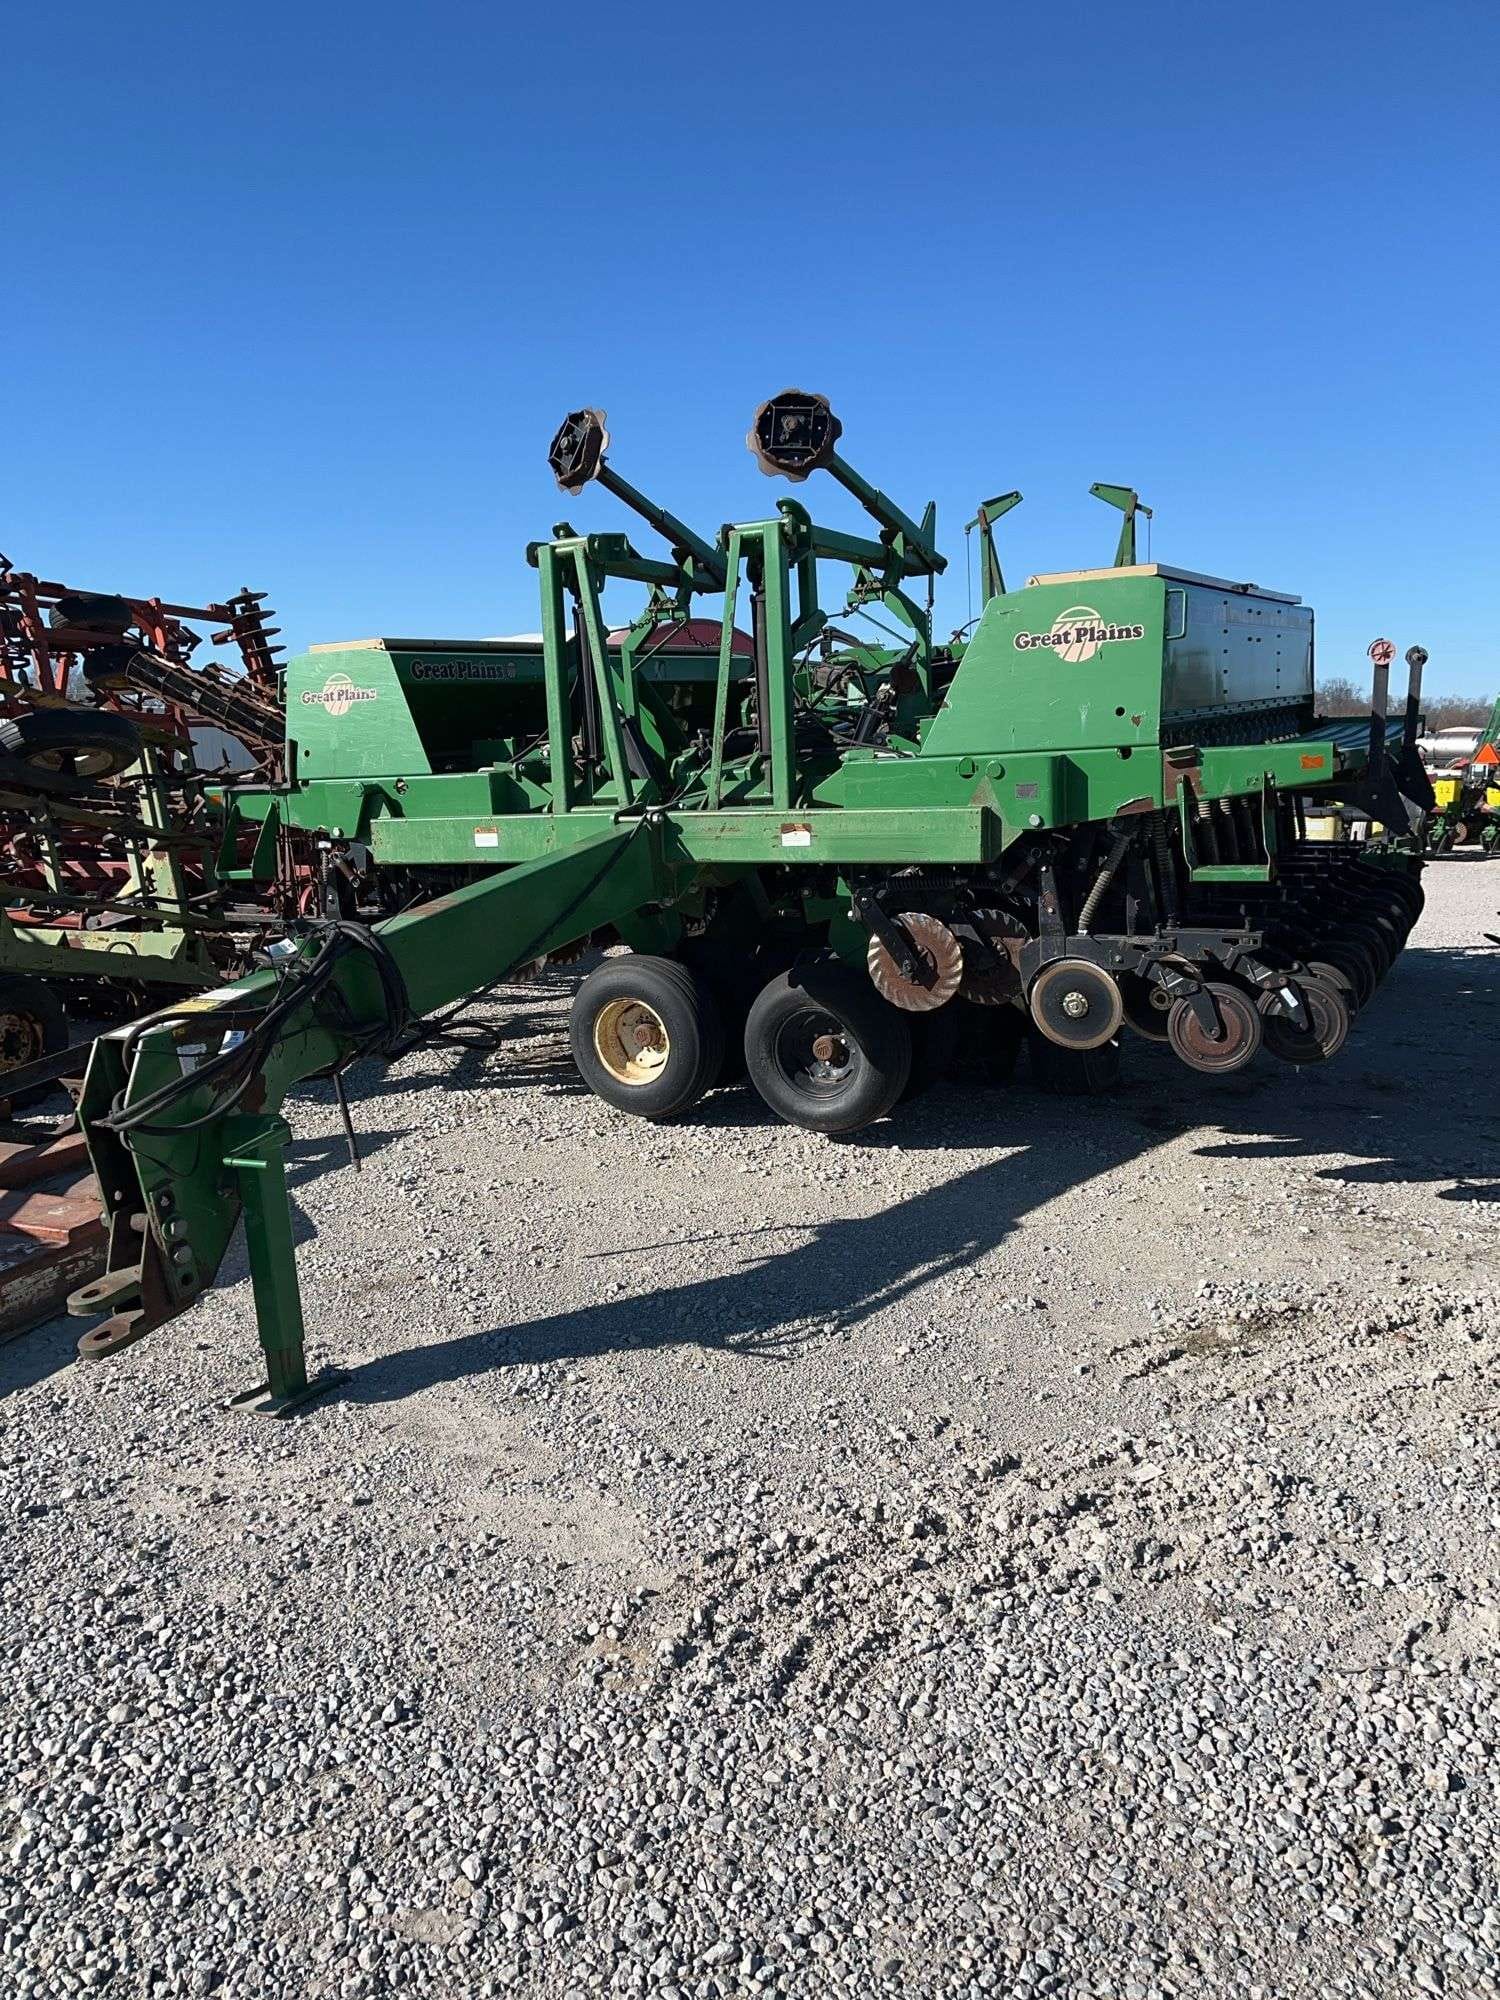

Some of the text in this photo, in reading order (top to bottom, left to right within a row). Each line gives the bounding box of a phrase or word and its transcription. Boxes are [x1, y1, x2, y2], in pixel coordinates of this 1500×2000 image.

[1014, 624, 1143, 650] Great Plains
[410, 660, 455, 679] Great
[302, 691, 334, 704] Great
